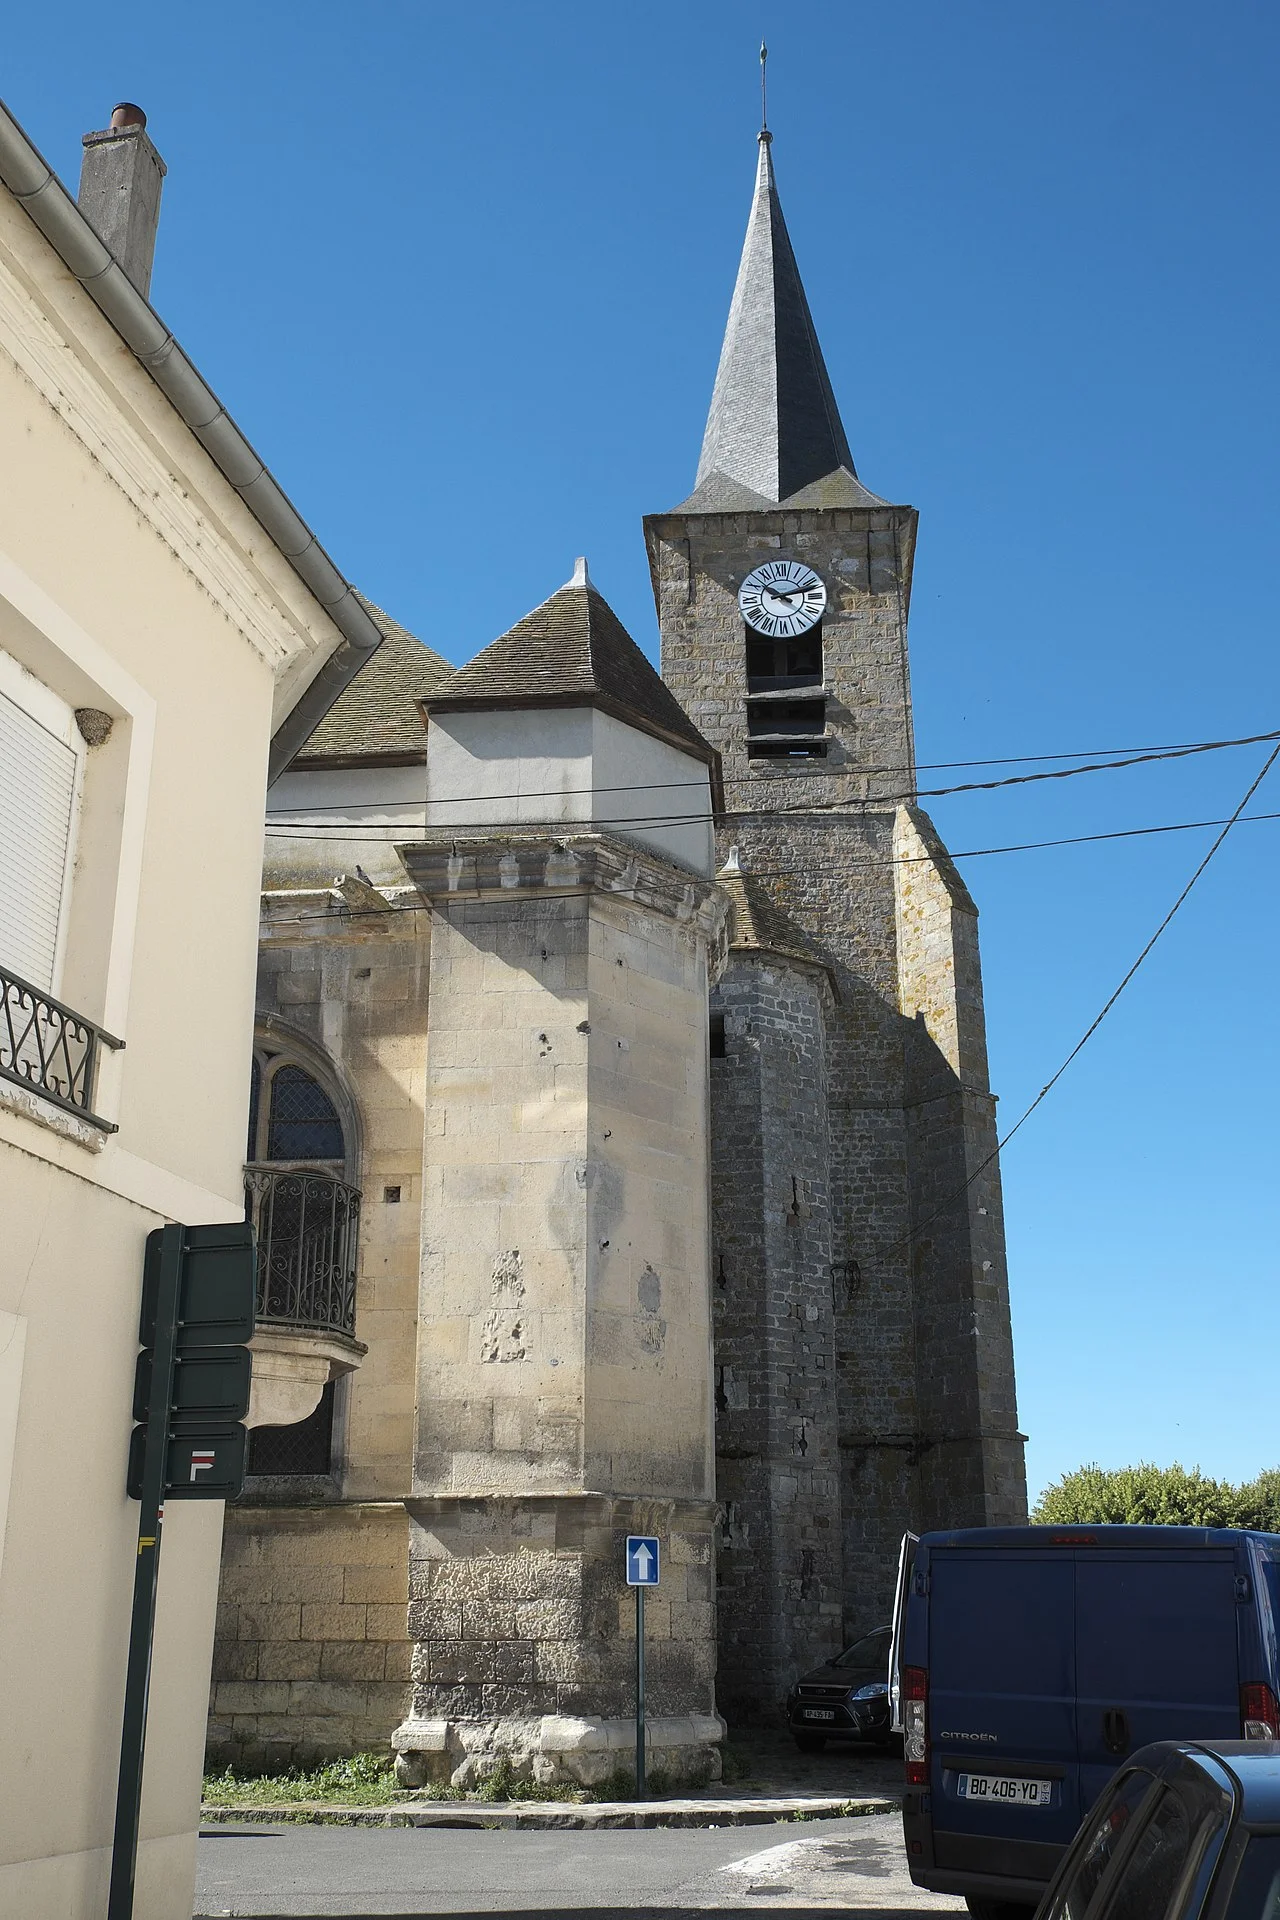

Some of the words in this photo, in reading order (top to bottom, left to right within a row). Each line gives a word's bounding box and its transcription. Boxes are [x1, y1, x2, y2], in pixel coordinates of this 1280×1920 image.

[758, 568, 772, 581] XI
[775, 564, 786, 576] XII
[743, 596, 758, 605] IX
[808, 592, 822, 600] III
[747, 607, 763, 623] VIII
[760, 617, 774, 633] VII
[780, 620, 789, 634] VI
[940, 1731, 998, 1742] CITROËN
